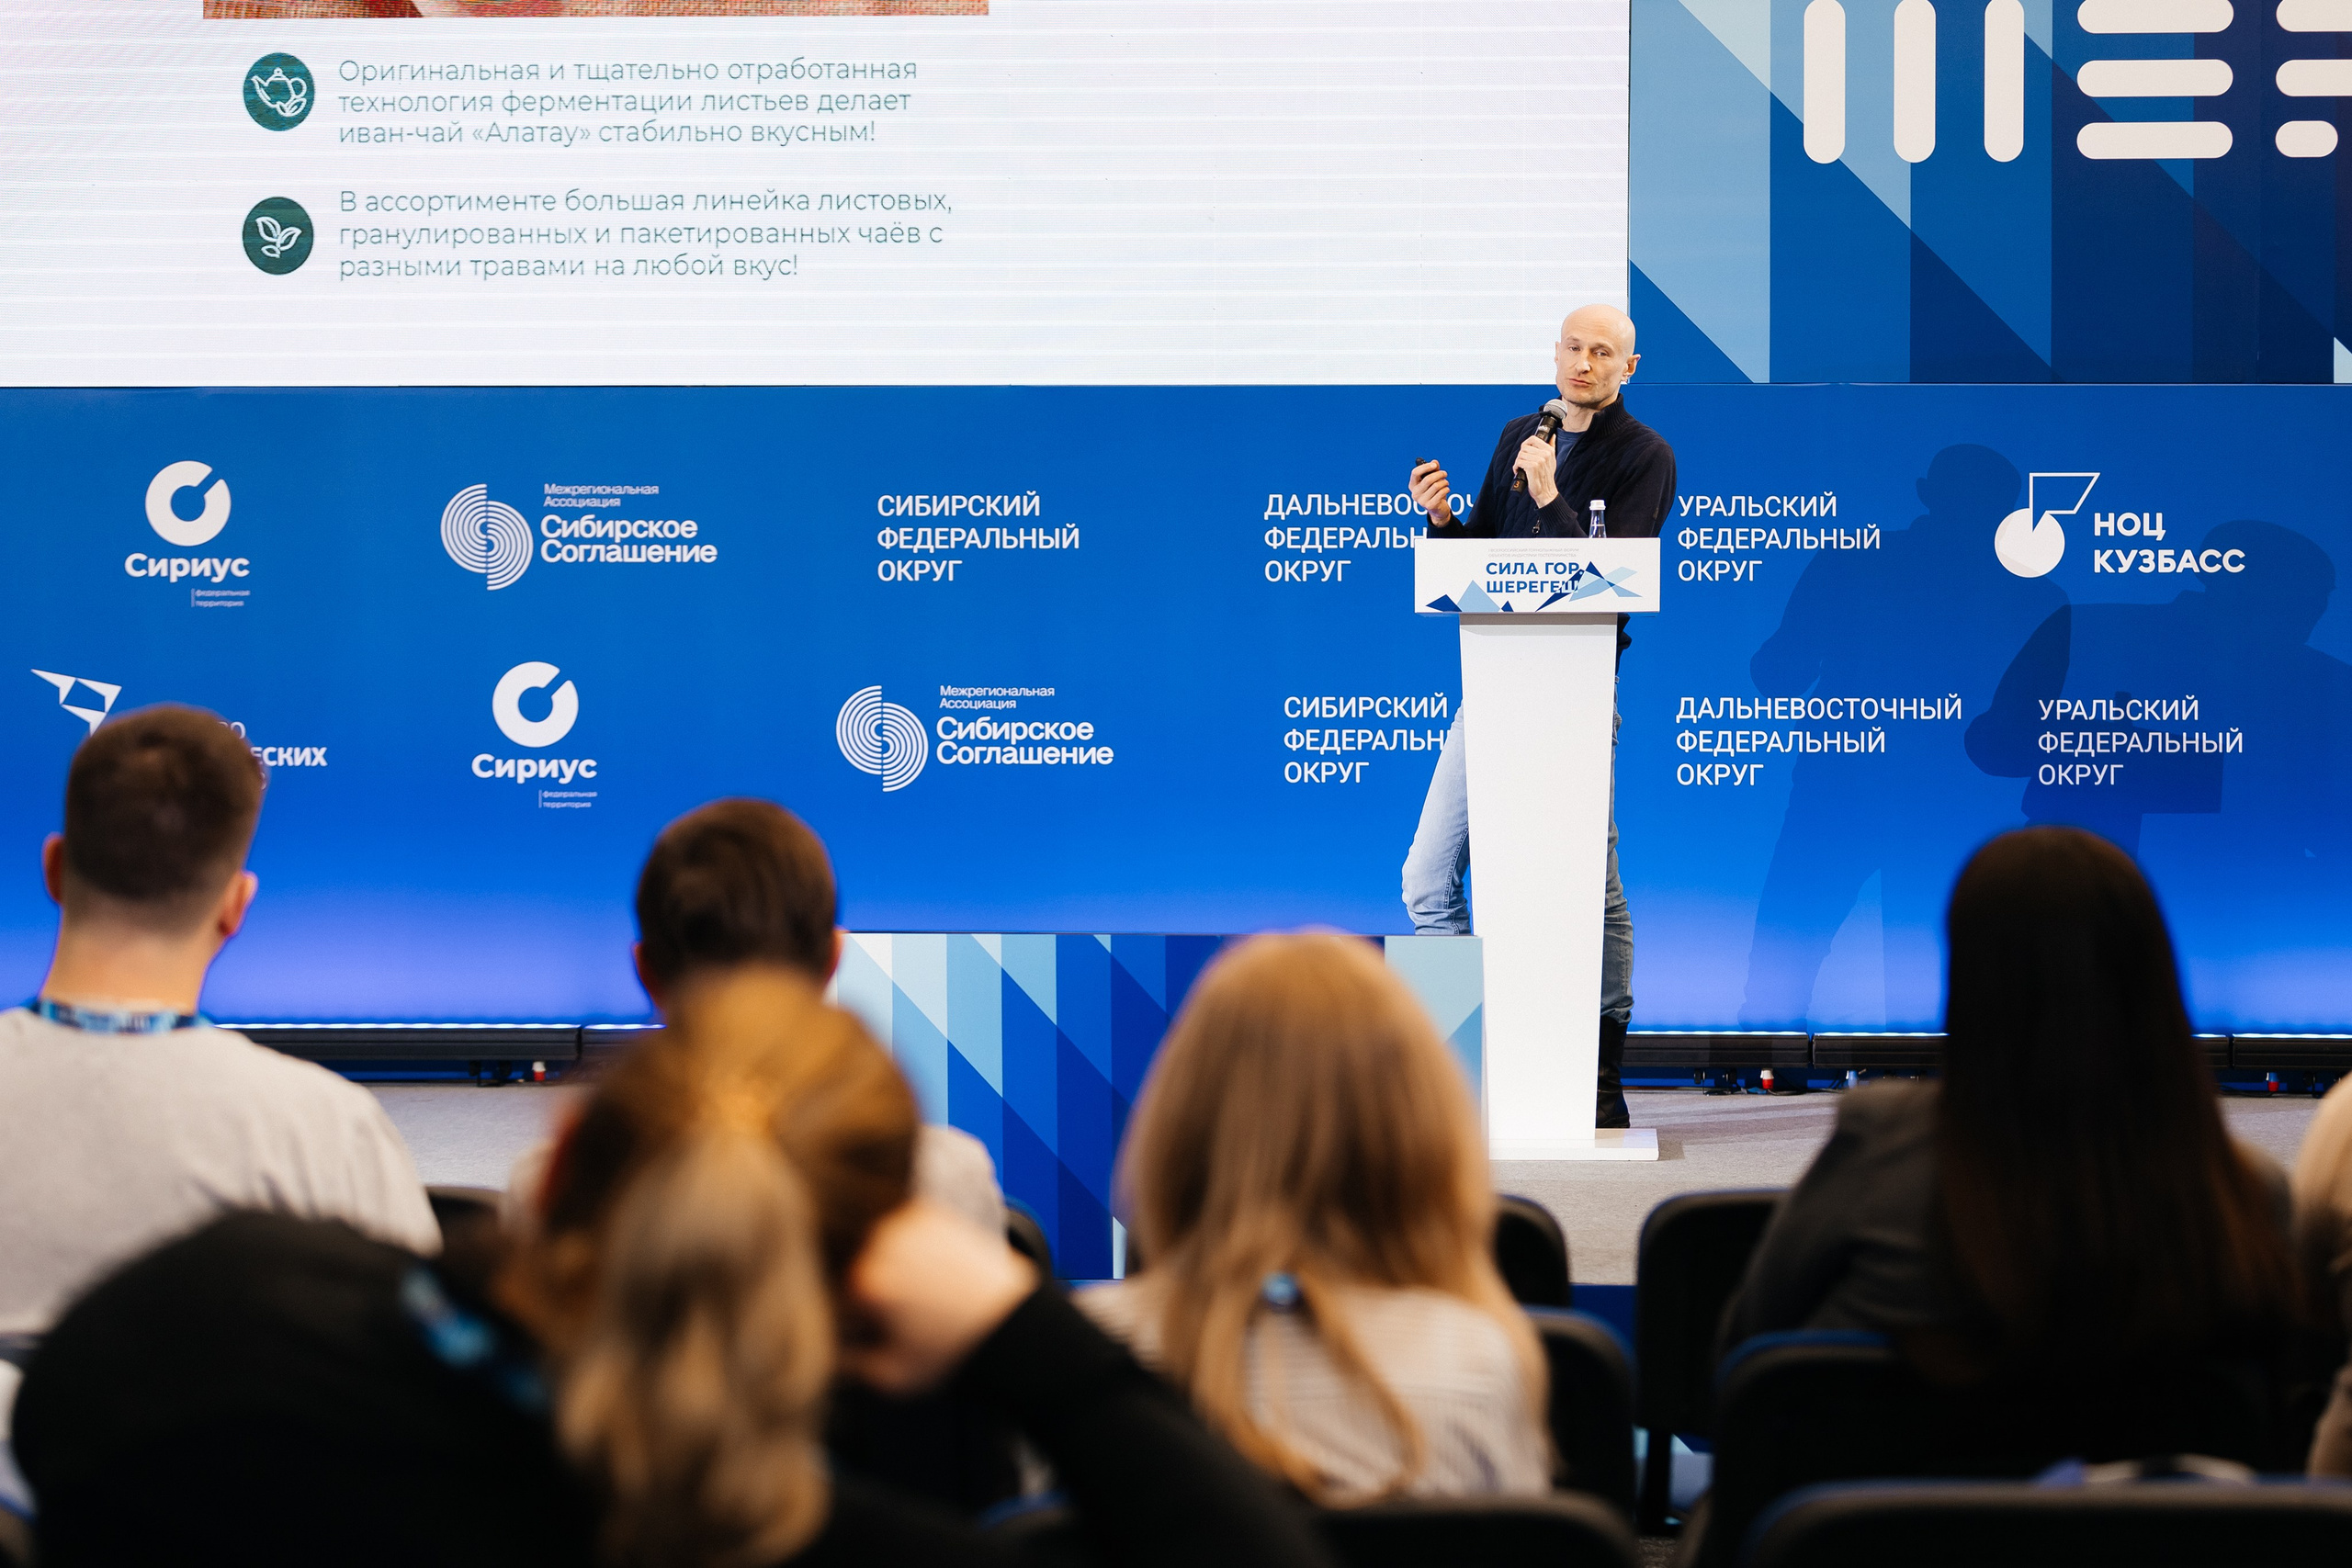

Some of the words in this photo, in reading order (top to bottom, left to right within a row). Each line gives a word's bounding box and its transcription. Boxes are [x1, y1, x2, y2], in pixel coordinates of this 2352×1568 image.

[339, 61, 541, 85] Оригинальная
[550, 63, 566, 80] и
[573, 63, 720, 83] тщательно
[728, 57, 918, 85] отработанная
[338, 96, 494, 112] технология
[502, 90, 693, 117] ферментации
[701, 95, 809, 110] листьев
[817, 94, 912, 114] делает
[340, 121, 464, 143] иван-чай
[473, 122, 592, 148] «Алатау»
[599, 119, 743, 141] стабильно
[752, 121, 876, 147] вкусным!
[341, 191, 358, 211] В
[366, 195, 558, 216] ассортименте
[565, 188, 685, 210] большая
[693, 188, 811, 210] линейка
[818, 194, 953, 214] листовых,
[340, 228, 588, 249] гранулированных
[596, 227, 612, 243] и
[621, 227, 852, 248] пакетированных
[858, 221, 922, 243] чаёв
[930, 226, 944, 243] с
[340, 260, 462, 281] разными
[469, 260, 586, 281] травами
[595, 259, 626, 276] на
[633, 253, 725, 276] любой
[734, 254, 798, 281] вкус!
[543, 496, 622, 509] Ассоциация
[544, 483, 660, 497] Межрегиональная
[877, 490, 1040, 517] СИБИРСКИЙ
[1678, 491, 1837, 517] УРАЛЬСКИЙ
[540, 514, 698, 539] Сибирское
[876, 523, 1080, 554] ФЕДЕРАЛЬНЫЙ
[1678, 523, 1881, 554] ФЕДЕРАЛЬНЫЙ
[2094, 512, 2166, 541] НОЦ
[540, 540, 718, 563] Соглашение
[2094, 548, 2245, 573] КУЗБАСС
[124, 552, 250, 583] Сириус
[877, 559, 963, 581] ОКРУГ
[1264, 559, 1351, 582] ОКРУГ
[1486, 562, 1539, 575] СИЛА
[1678, 559, 1763, 581] ОКРУГ
[1487, 581, 1578, 593] ШЕРЕГЕШ
[939, 684, 1056, 698] Межрегиональная
[939, 697, 1018, 711] Ассоциация
[1283, 692, 1448, 718] СИБИРСКИЙ
[1676, 693, 1962, 724] ДАЛЬНЕВОСТОЧНЫЙ
[2038, 694, 2199, 721] УРАЛЬСКИЙ
[936, 716, 1094, 742] Сибирское
[1283, 728, 1452, 756] ФЕДЕРАЛЬН
[1676, 726, 1885, 758] ФЕДЕРАЛЬНЫЙ
[936, 741, 1114, 765] Соглашение
[2038, 727, 2243, 758] ФЕДЕРАЛЬНЫЙ
[471, 753, 597, 784] Сириус
[1283, 761, 1370, 784] ОКРУГ
[1677, 763, 1764, 786] ОКРУГ
[2039, 763, 2124, 785] ОКРУГ
